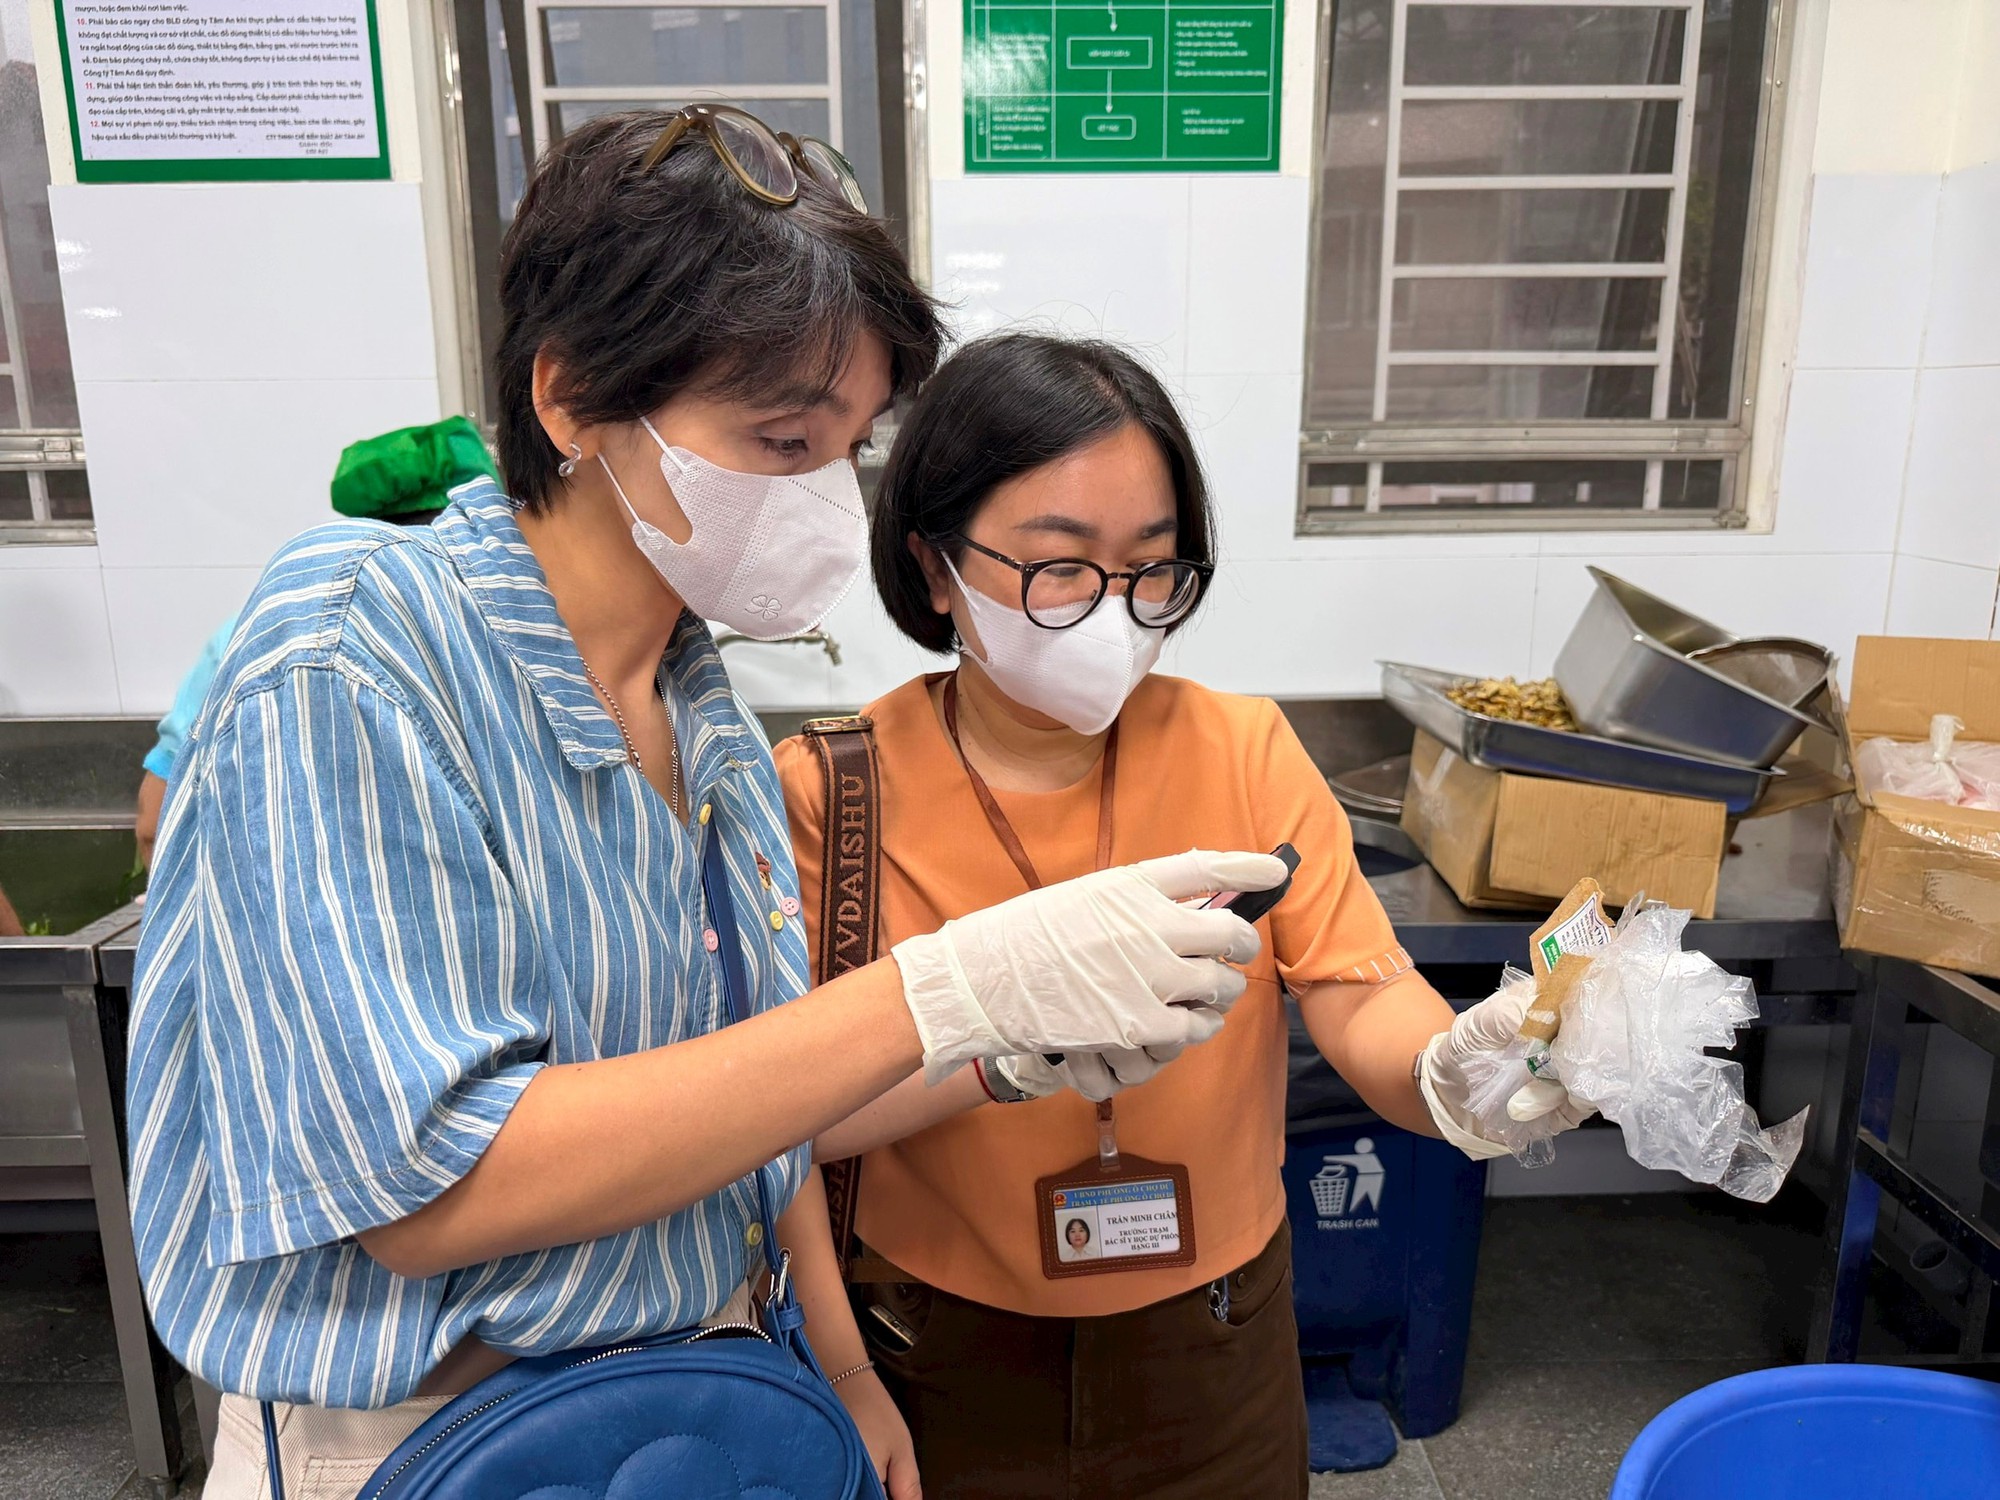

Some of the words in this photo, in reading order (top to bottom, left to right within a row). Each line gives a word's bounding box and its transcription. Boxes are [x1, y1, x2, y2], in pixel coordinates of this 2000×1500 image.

[182, 17, 200, 26] công
[225, 16, 235, 24] An
[78, 30, 100, 39] không
[220, 55, 243, 64] không
[125, 68, 135, 76] An
[1074, 1190, 1096, 1198] UBND
[1107, 1214, 1130, 1225] TRẦN
[1130, 1213, 1153, 1222] MINH
[1316, 1219, 1354, 1230] TRASH
[1354, 1218, 1379, 1229] CAN
[1149, 1226, 1169, 1234] TRẠM
[1104, 1236, 1119, 1246] BÁC
[1134, 1235, 1149, 1244] HỌC
[1131, 1243, 1151, 1251] HẠNG
